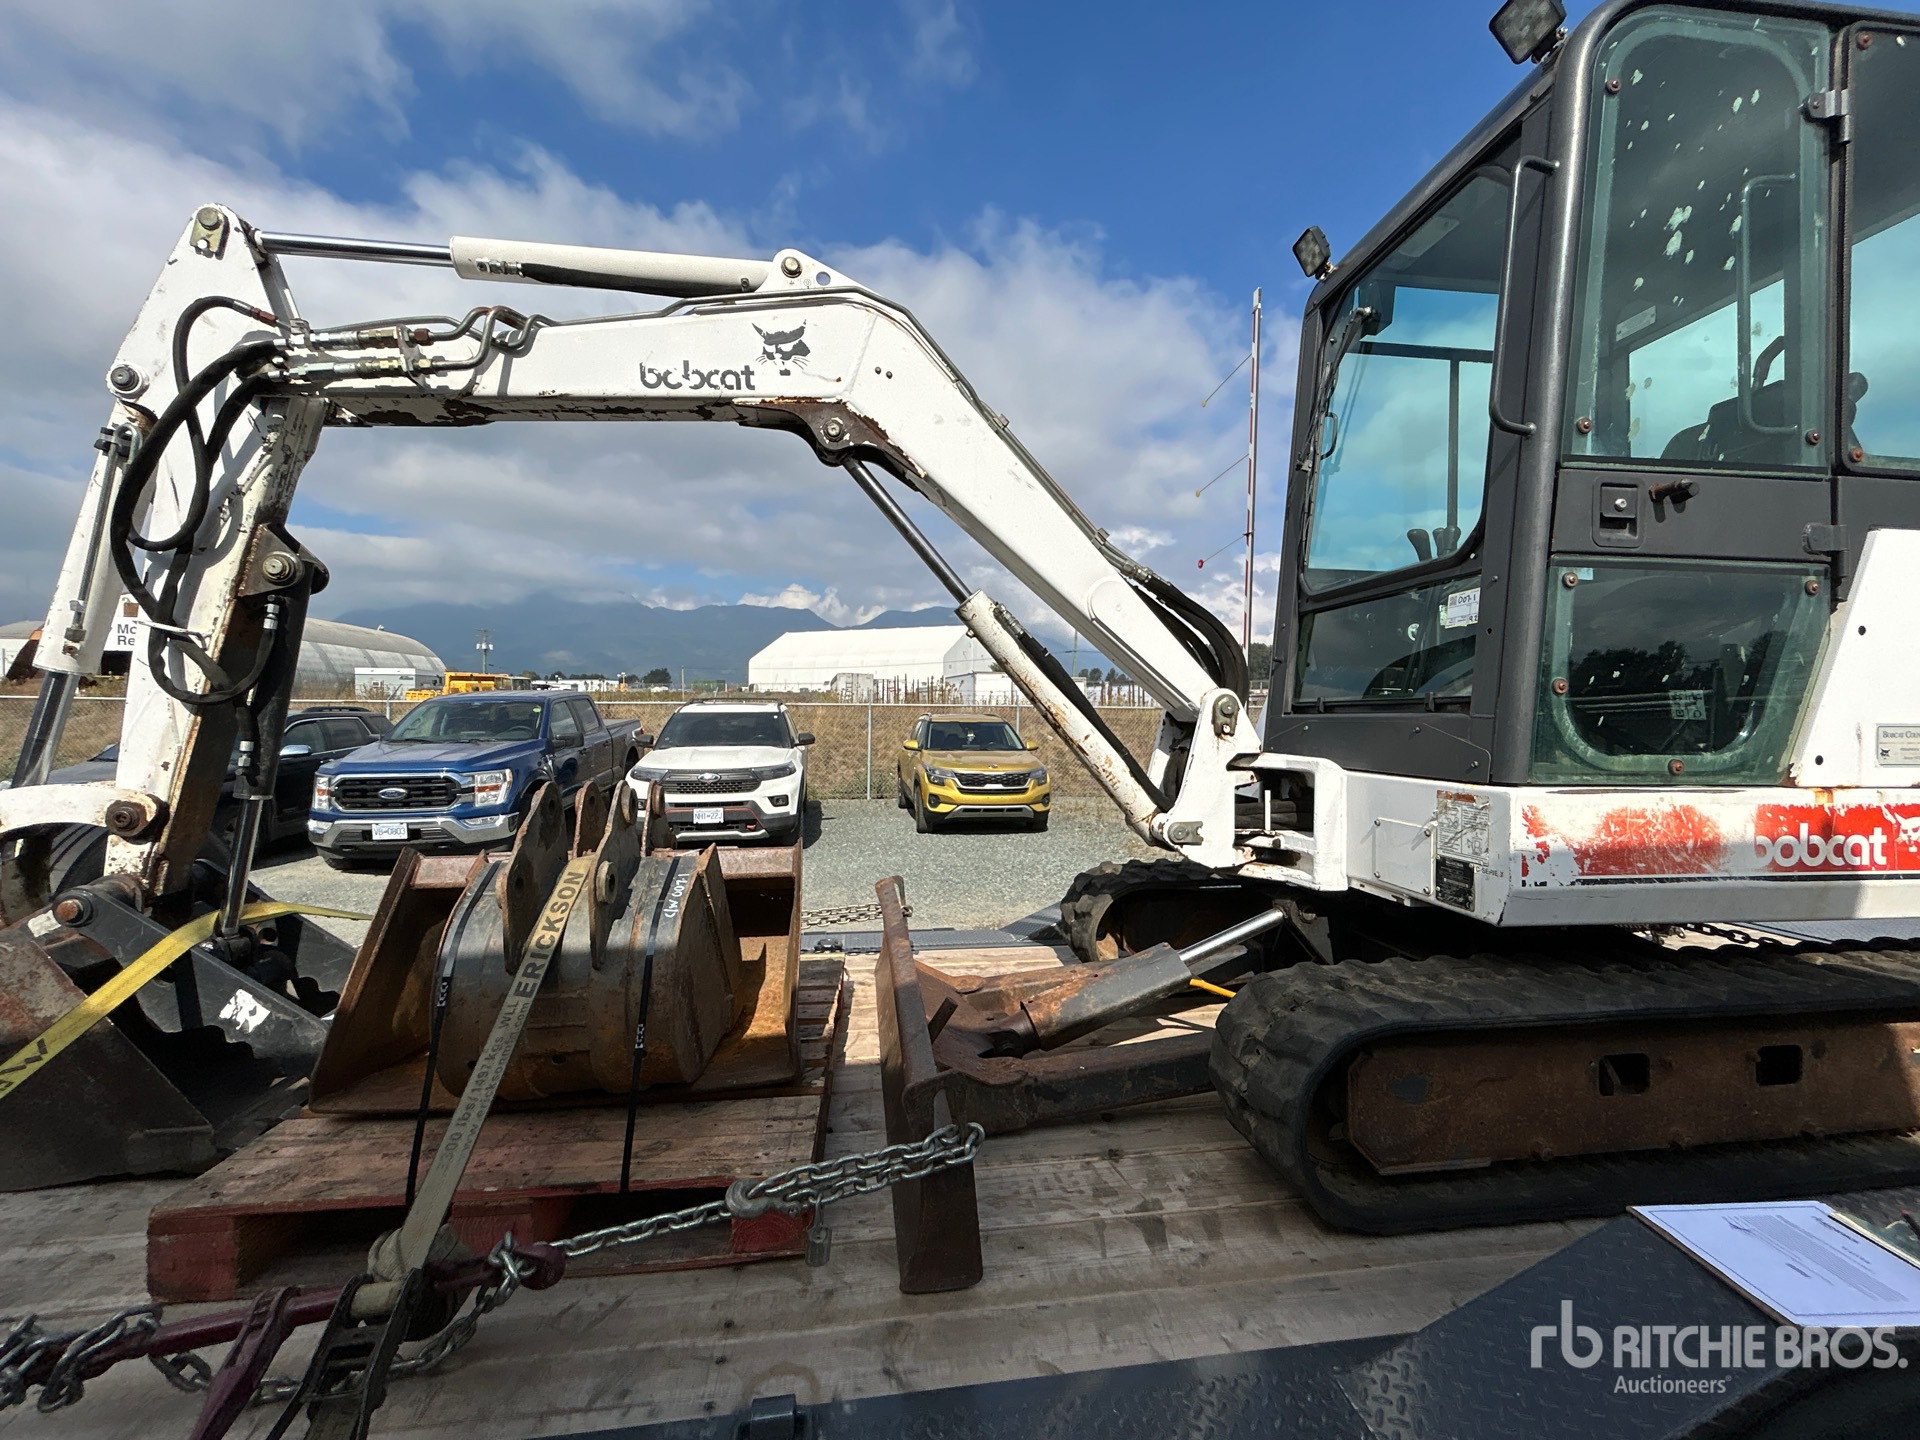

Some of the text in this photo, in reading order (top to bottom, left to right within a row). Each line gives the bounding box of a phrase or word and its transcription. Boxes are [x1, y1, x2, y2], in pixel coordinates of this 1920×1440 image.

[639, 359, 756, 391] bobcat
[1748, 822, 1887, 867] bobcat
[515, 871, 585, 998] ERICKSON
[498, 1000, 519, 1030] WLL
